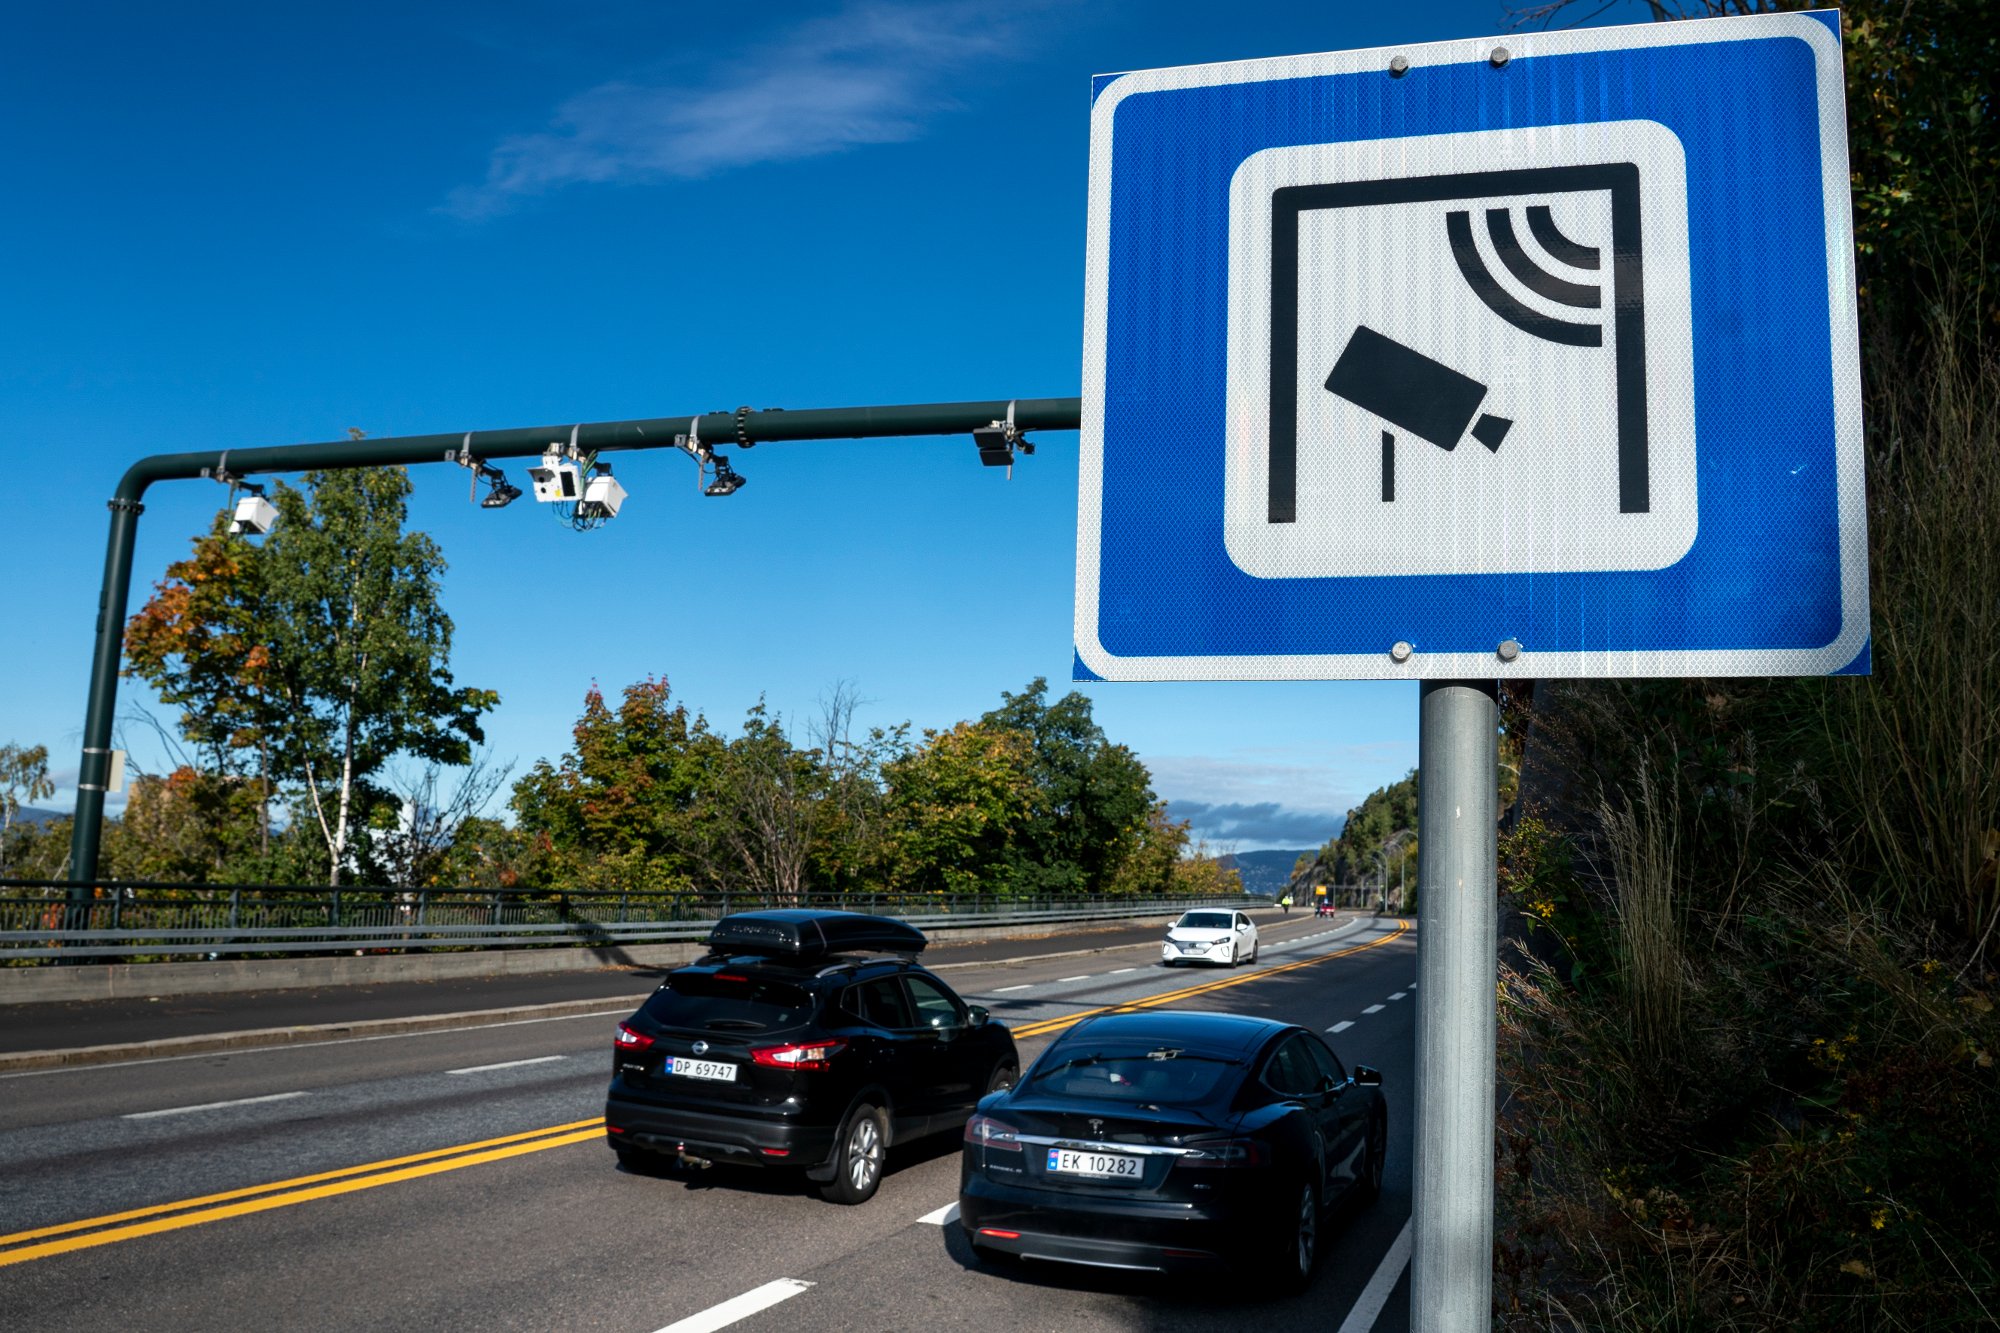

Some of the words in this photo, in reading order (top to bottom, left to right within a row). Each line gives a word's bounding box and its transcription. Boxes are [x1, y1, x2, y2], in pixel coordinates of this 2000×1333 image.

[675, 1060, 690, 1073] DP
[696, 1063, 732, 1078] 69747
[1062, 1153, 1081, 1170] EK
[1089, 1155, 1137, 1175] 10282
